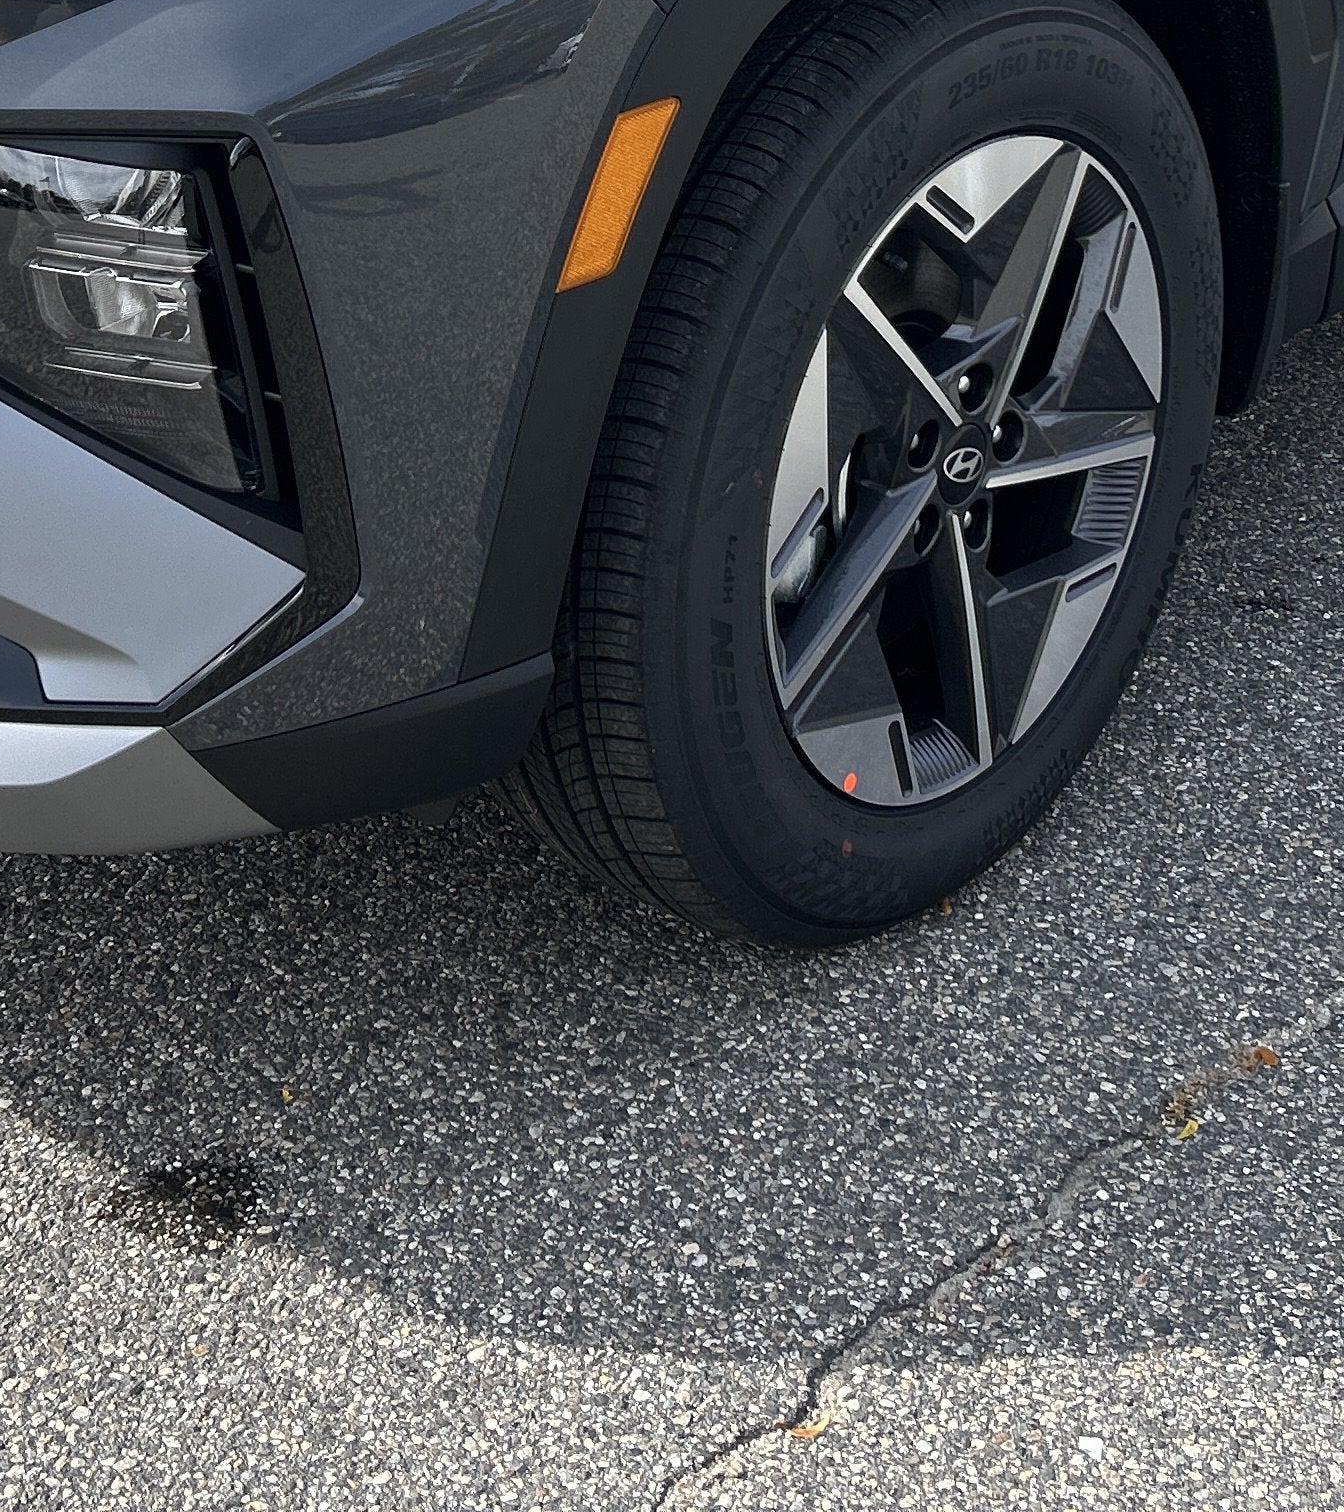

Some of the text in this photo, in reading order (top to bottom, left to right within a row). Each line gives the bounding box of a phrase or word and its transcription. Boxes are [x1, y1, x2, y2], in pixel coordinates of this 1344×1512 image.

[948, 52, 1028, 110] 235/60
[1034, 48, 1079, 72] R18
[720, 535, 739, 605] HP71
